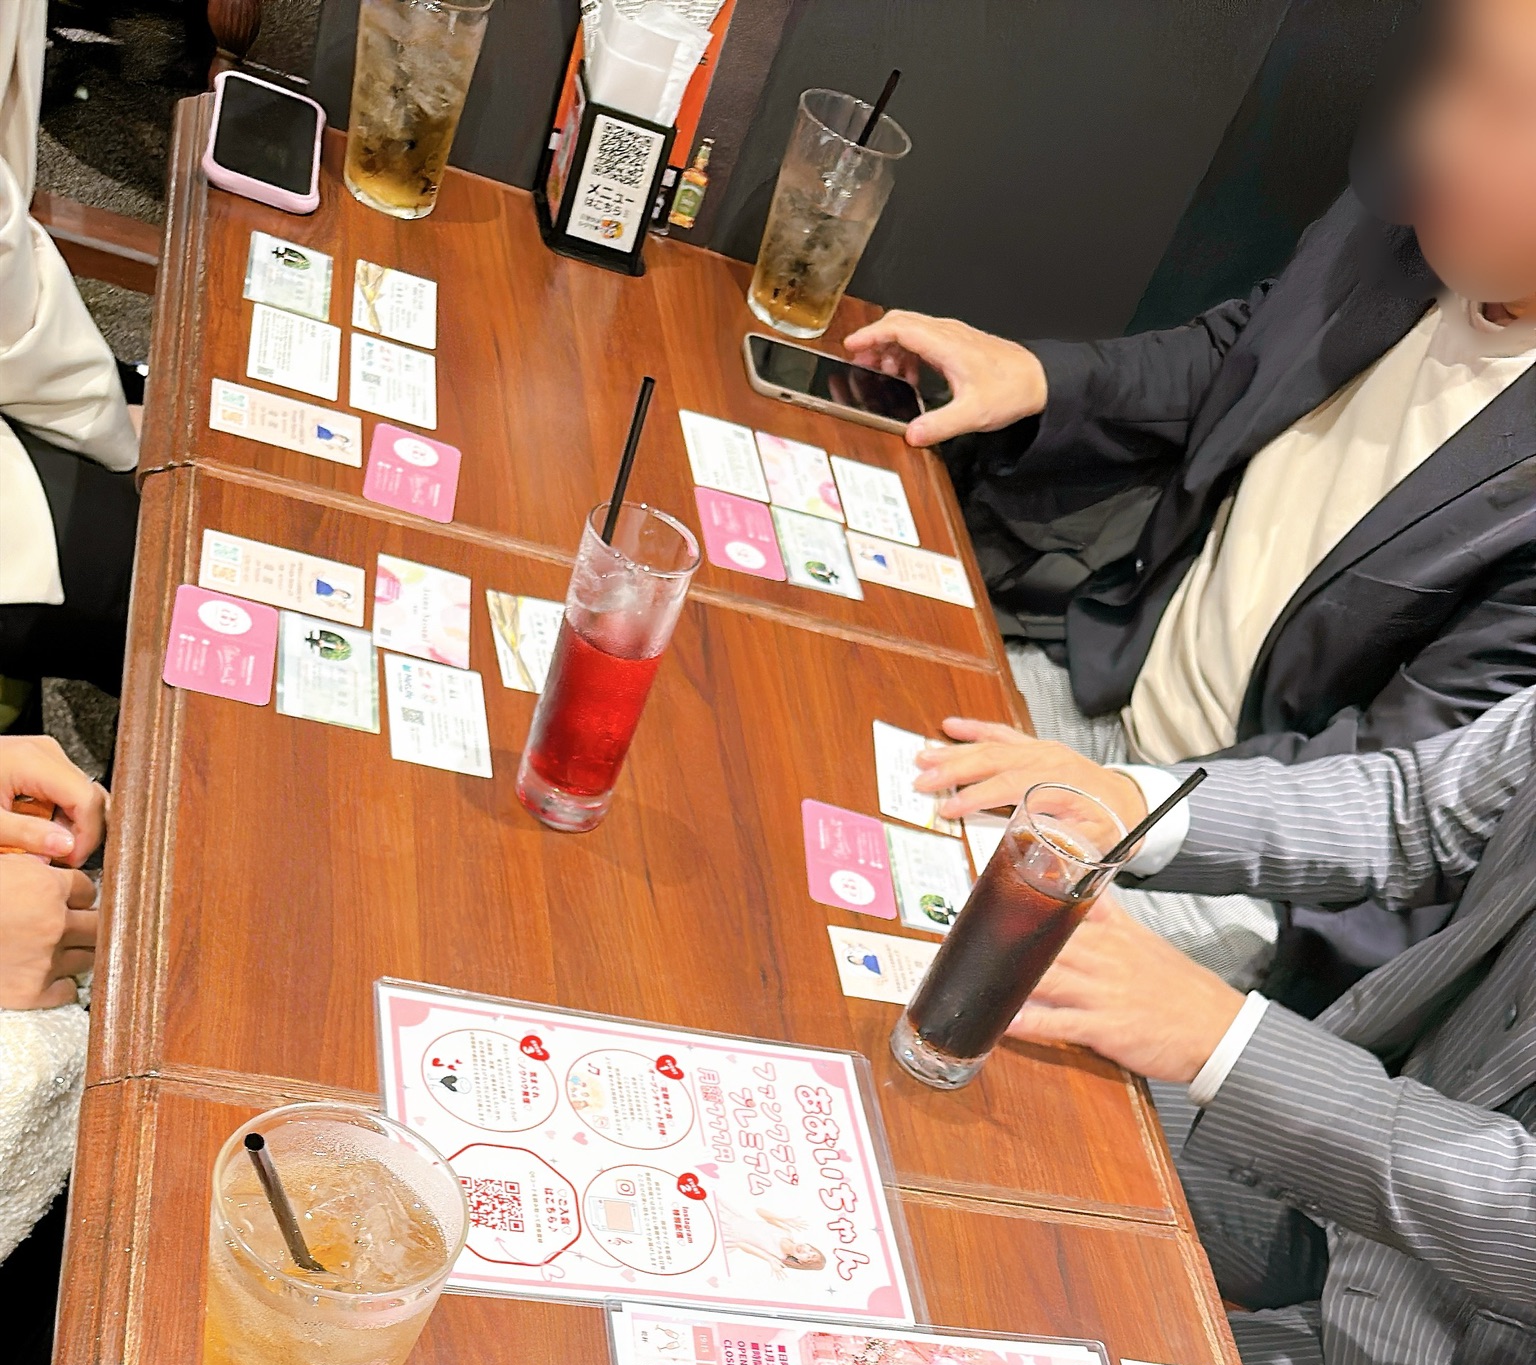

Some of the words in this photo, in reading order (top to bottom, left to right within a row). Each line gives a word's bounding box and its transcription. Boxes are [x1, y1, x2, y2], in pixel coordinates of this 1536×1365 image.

[697, 1067, 735, 1163] 月額777円
[728, 1087, 772, 1196] プレミアム
[752, 1062, 799, 1186] ファンクラブ
[679, 1183, 692, 1193] 2
[682, 1206, 694, 1244] Instagram
[794, 1085, 871, 1281] あおいちゃん
[737, 1340, 749, 1365] OPEN
